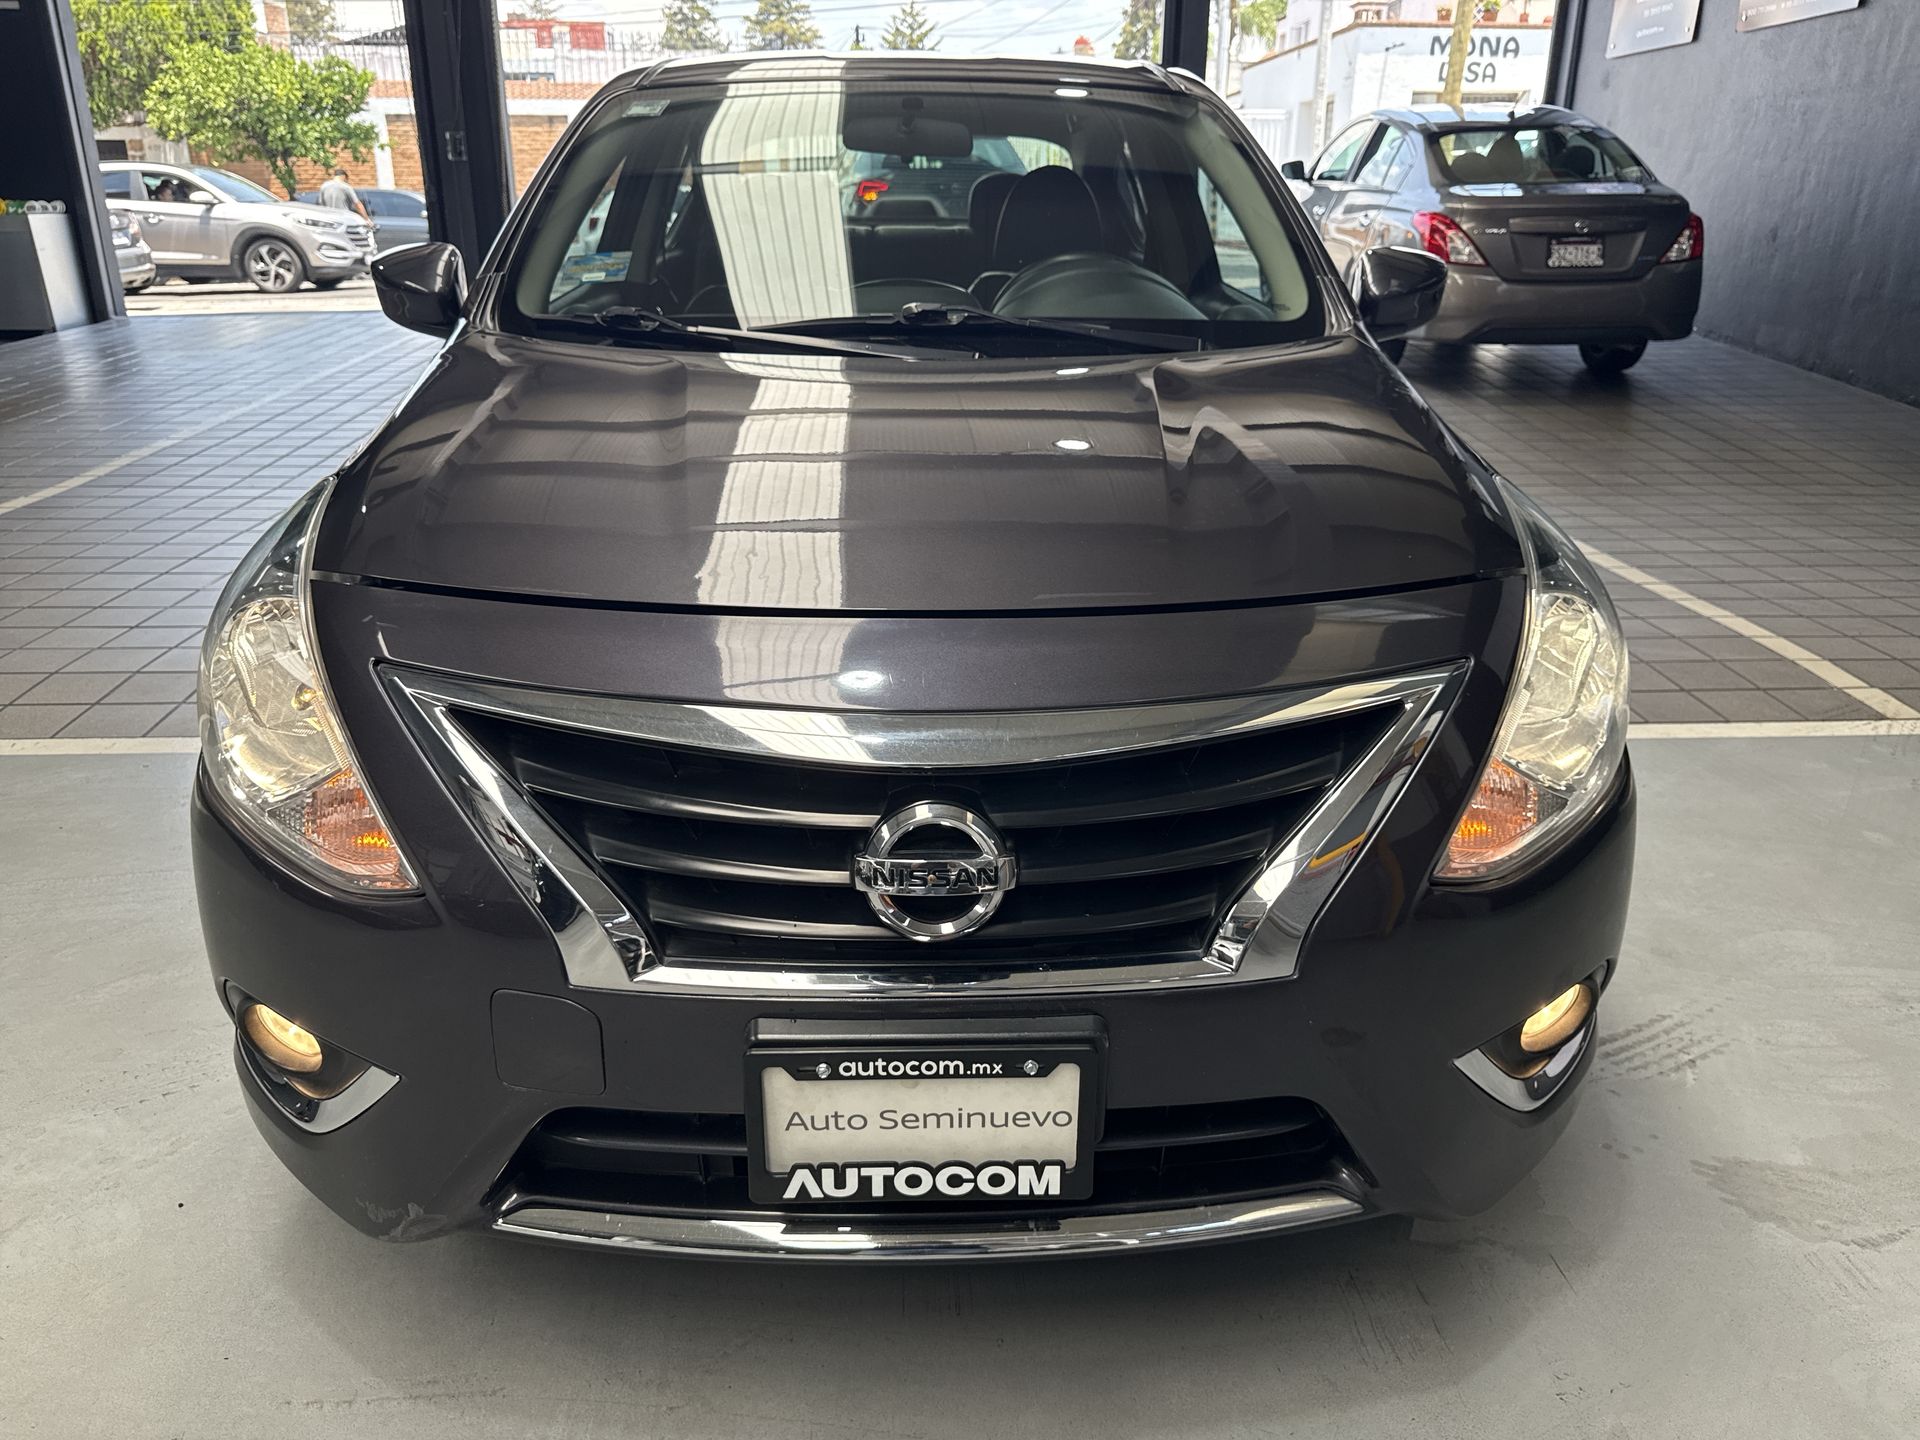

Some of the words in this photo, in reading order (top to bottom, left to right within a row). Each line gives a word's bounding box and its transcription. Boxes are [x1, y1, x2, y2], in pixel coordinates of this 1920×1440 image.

[1438, 61, 1496, 83] LSA
[871, 866, 999, 889] NISSAN
[838, 1057, 1003, 1077] autocom.mx
[784, 1111, 868, 1131] Auto
[878, 1108, 1073, 1130] Seminuevo
[782, 1164, 1061, 1198] AUTOCOM
